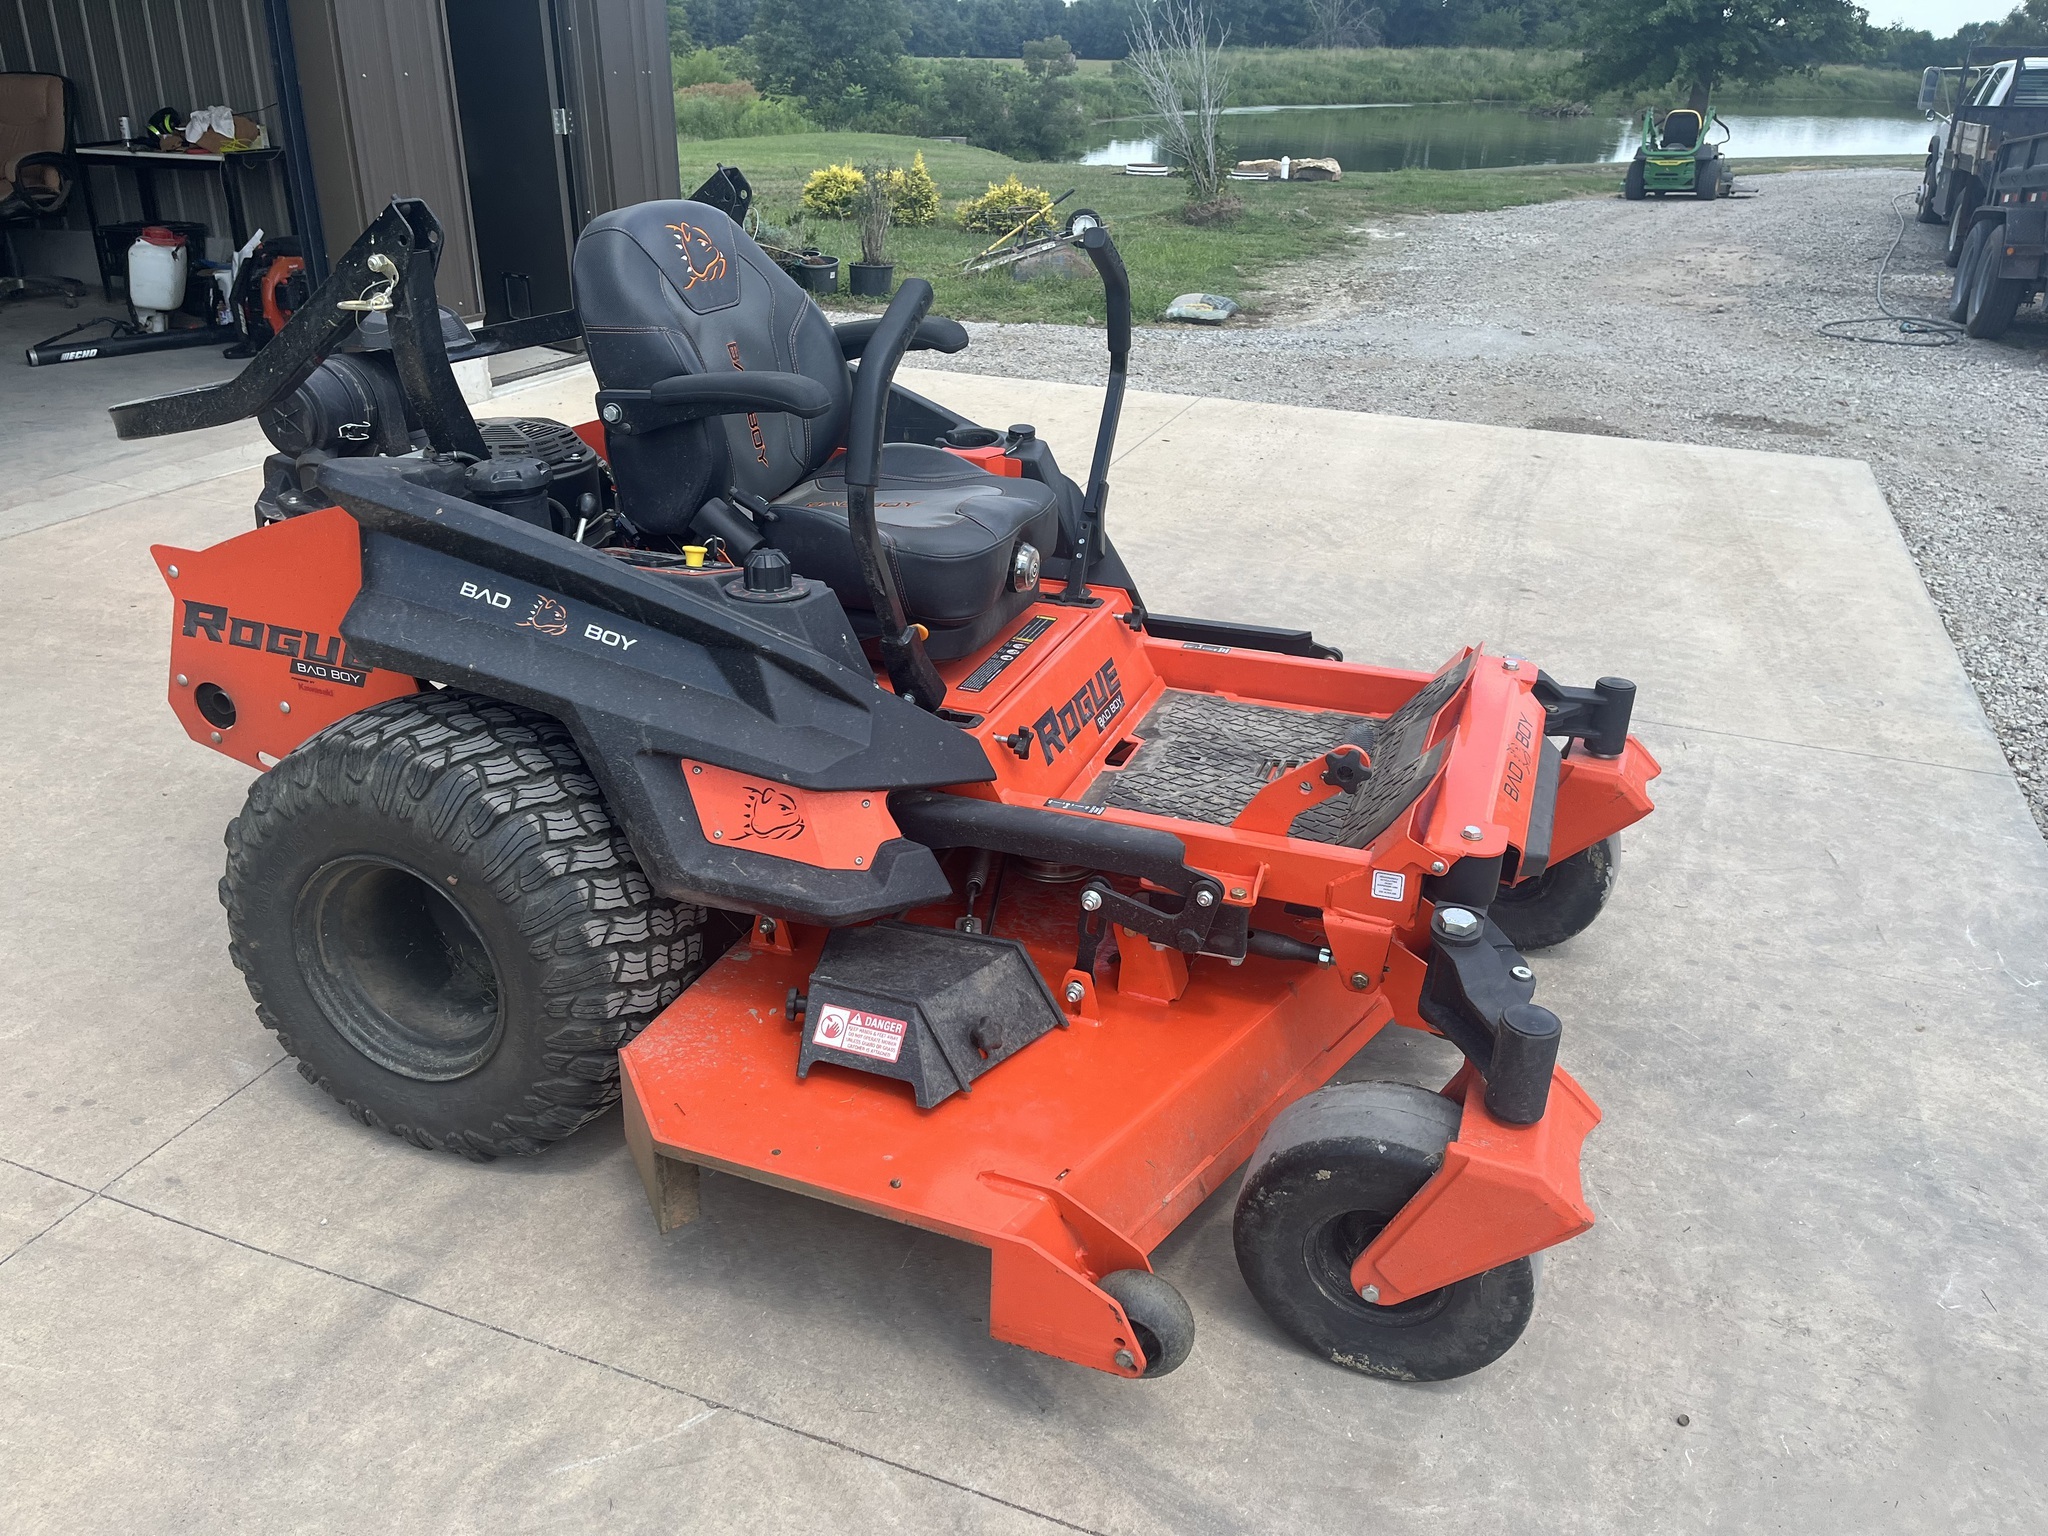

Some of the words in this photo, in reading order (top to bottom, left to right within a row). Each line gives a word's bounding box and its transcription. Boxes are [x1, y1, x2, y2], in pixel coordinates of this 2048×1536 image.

[69, 348, 98, 360] ECHO
[459, 581, 512, 609] BAD
[583, 623, 638, 651] BOY
[296, 662, 327, 677] BAD
[330, 669, 360, 684] BOY
[298, 682, 334, 697] Kawasaki
[1032, 656, 1122, 767] ROGUE
[1097, 708, 1111, 728] BAD
[1109, 694, 1123, 714] BOY
[1503, 761, 1524, 803] BAD
[1515, 711, 1533, 749] BOY
[864, 1016, 903, 1034] DANGER
[863, 1035, 880, 1043] OPERATE
